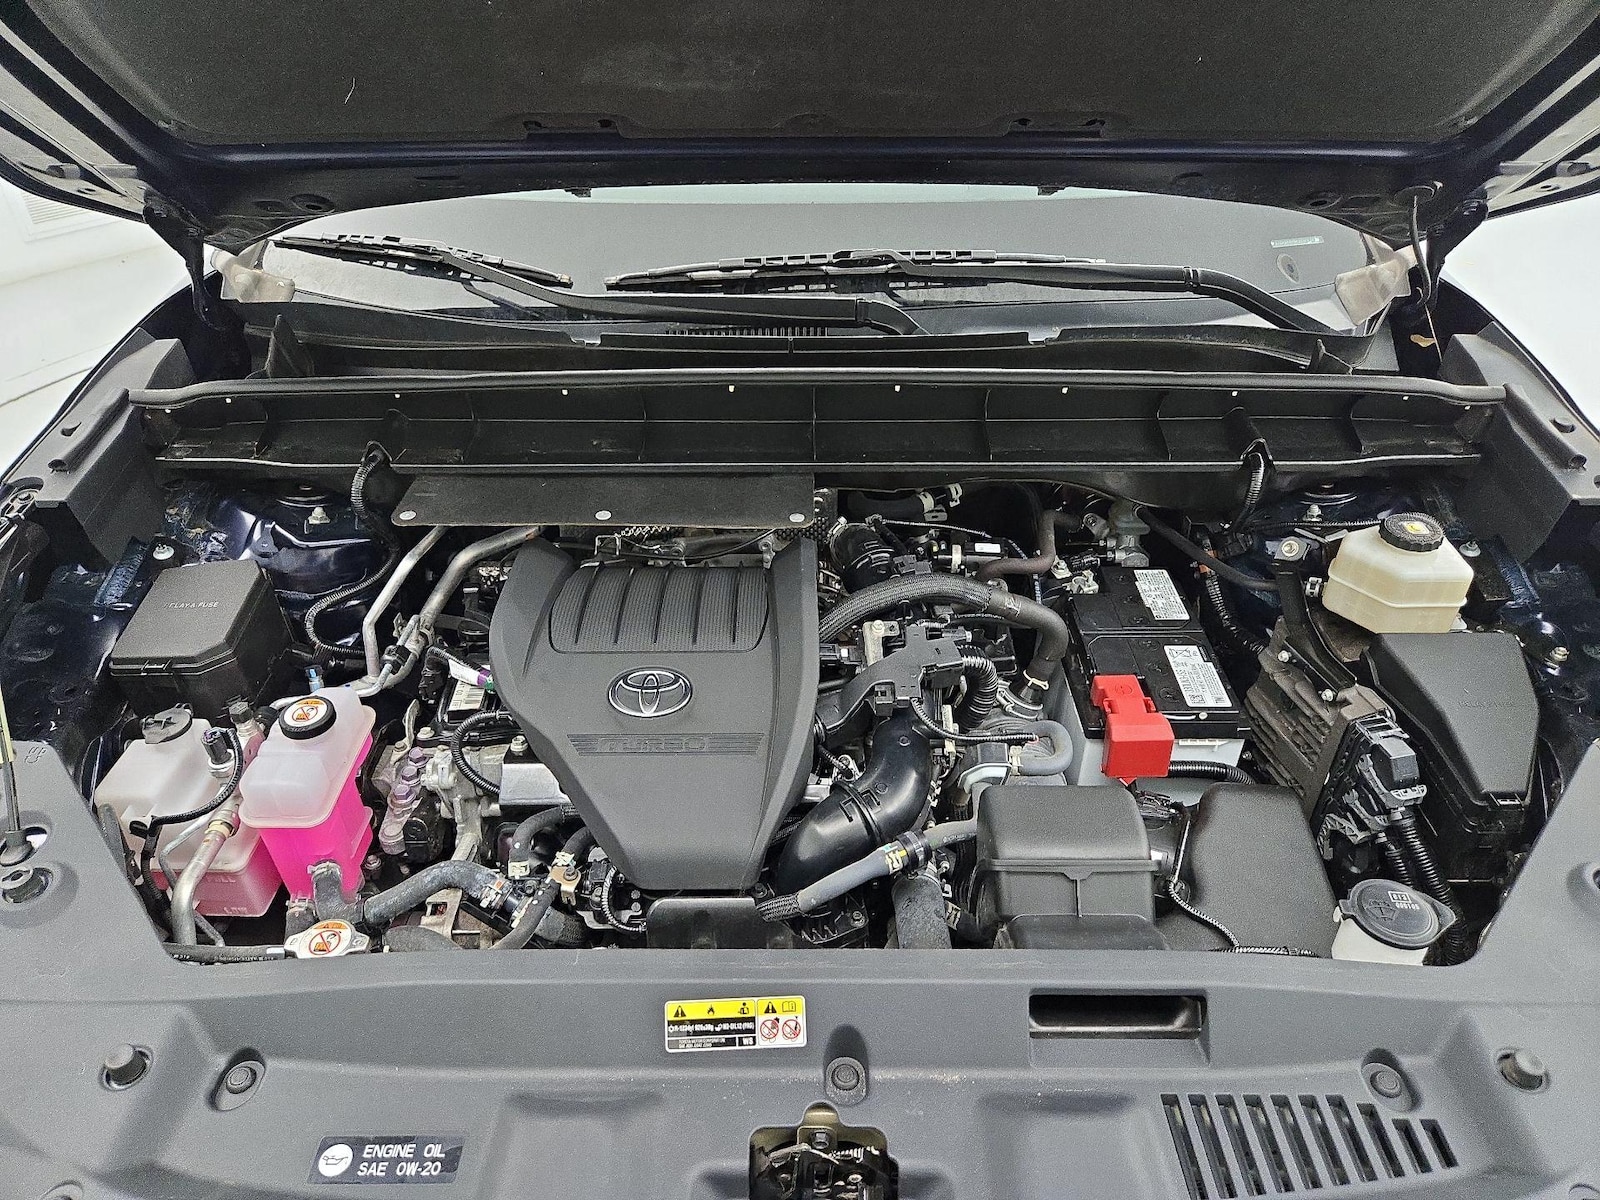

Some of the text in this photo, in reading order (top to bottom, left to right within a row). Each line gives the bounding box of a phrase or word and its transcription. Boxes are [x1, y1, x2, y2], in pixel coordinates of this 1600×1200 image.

[597, 738, 706, 751] TURBO
[362, 1143, 446, 1158] ENGINE OIL
[356, 1161, 442, 1176] SAE 0W-20
